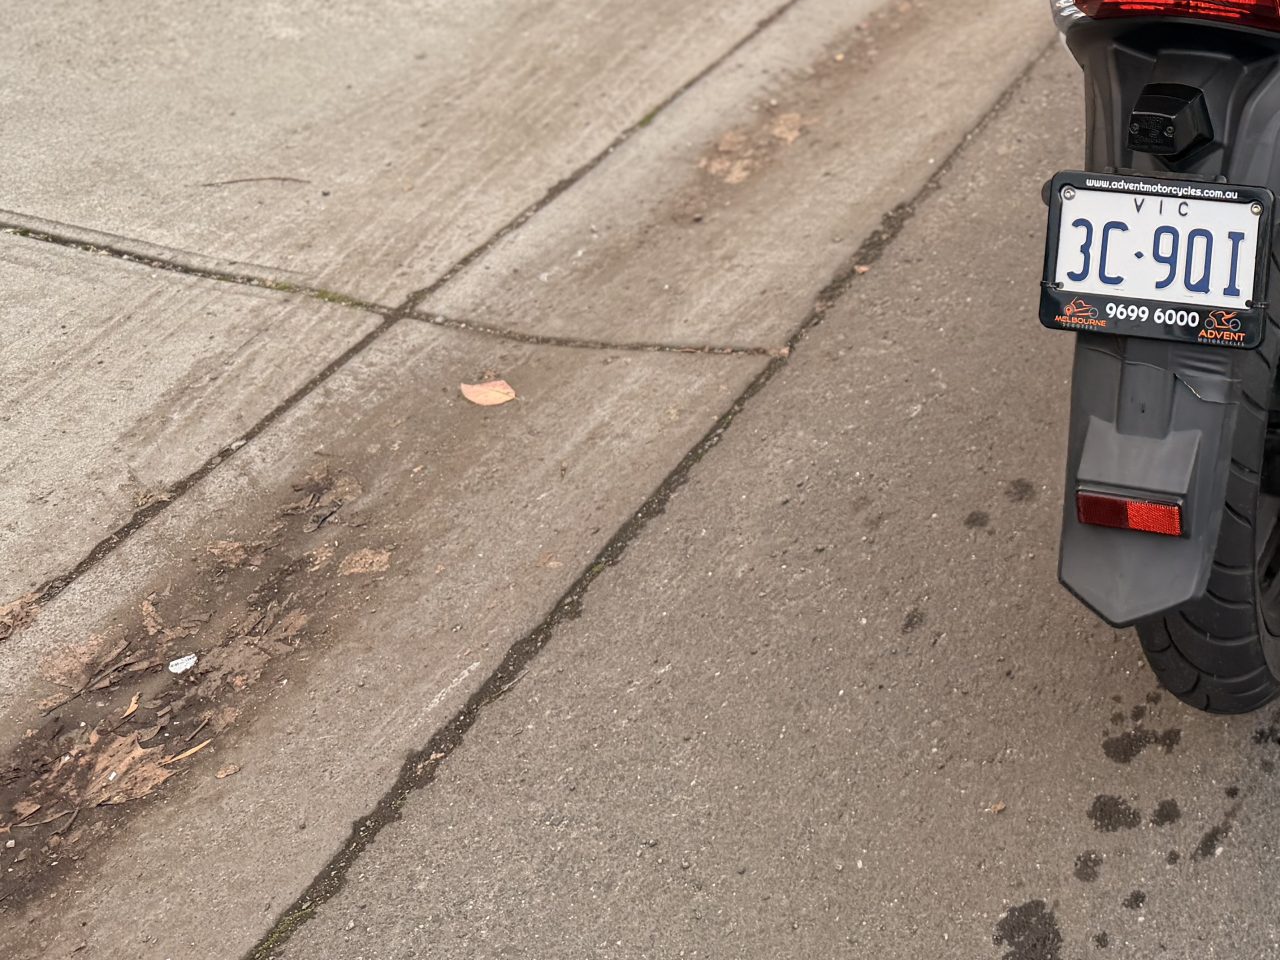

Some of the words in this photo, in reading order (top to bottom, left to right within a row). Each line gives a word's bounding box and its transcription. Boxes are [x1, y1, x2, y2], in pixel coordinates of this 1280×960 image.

[1085, 177, 1239, 200] www.adventmotorcycles.com.au
[1133, 197, 1190, 217] VIC
[1054, 314, 1108, 328] MELBOURNE
[1105, 302, 1150, 322] 9699
[1153, 308, 1200, 328] 6000
[1198, 328, 1247, 342] ADVENT
